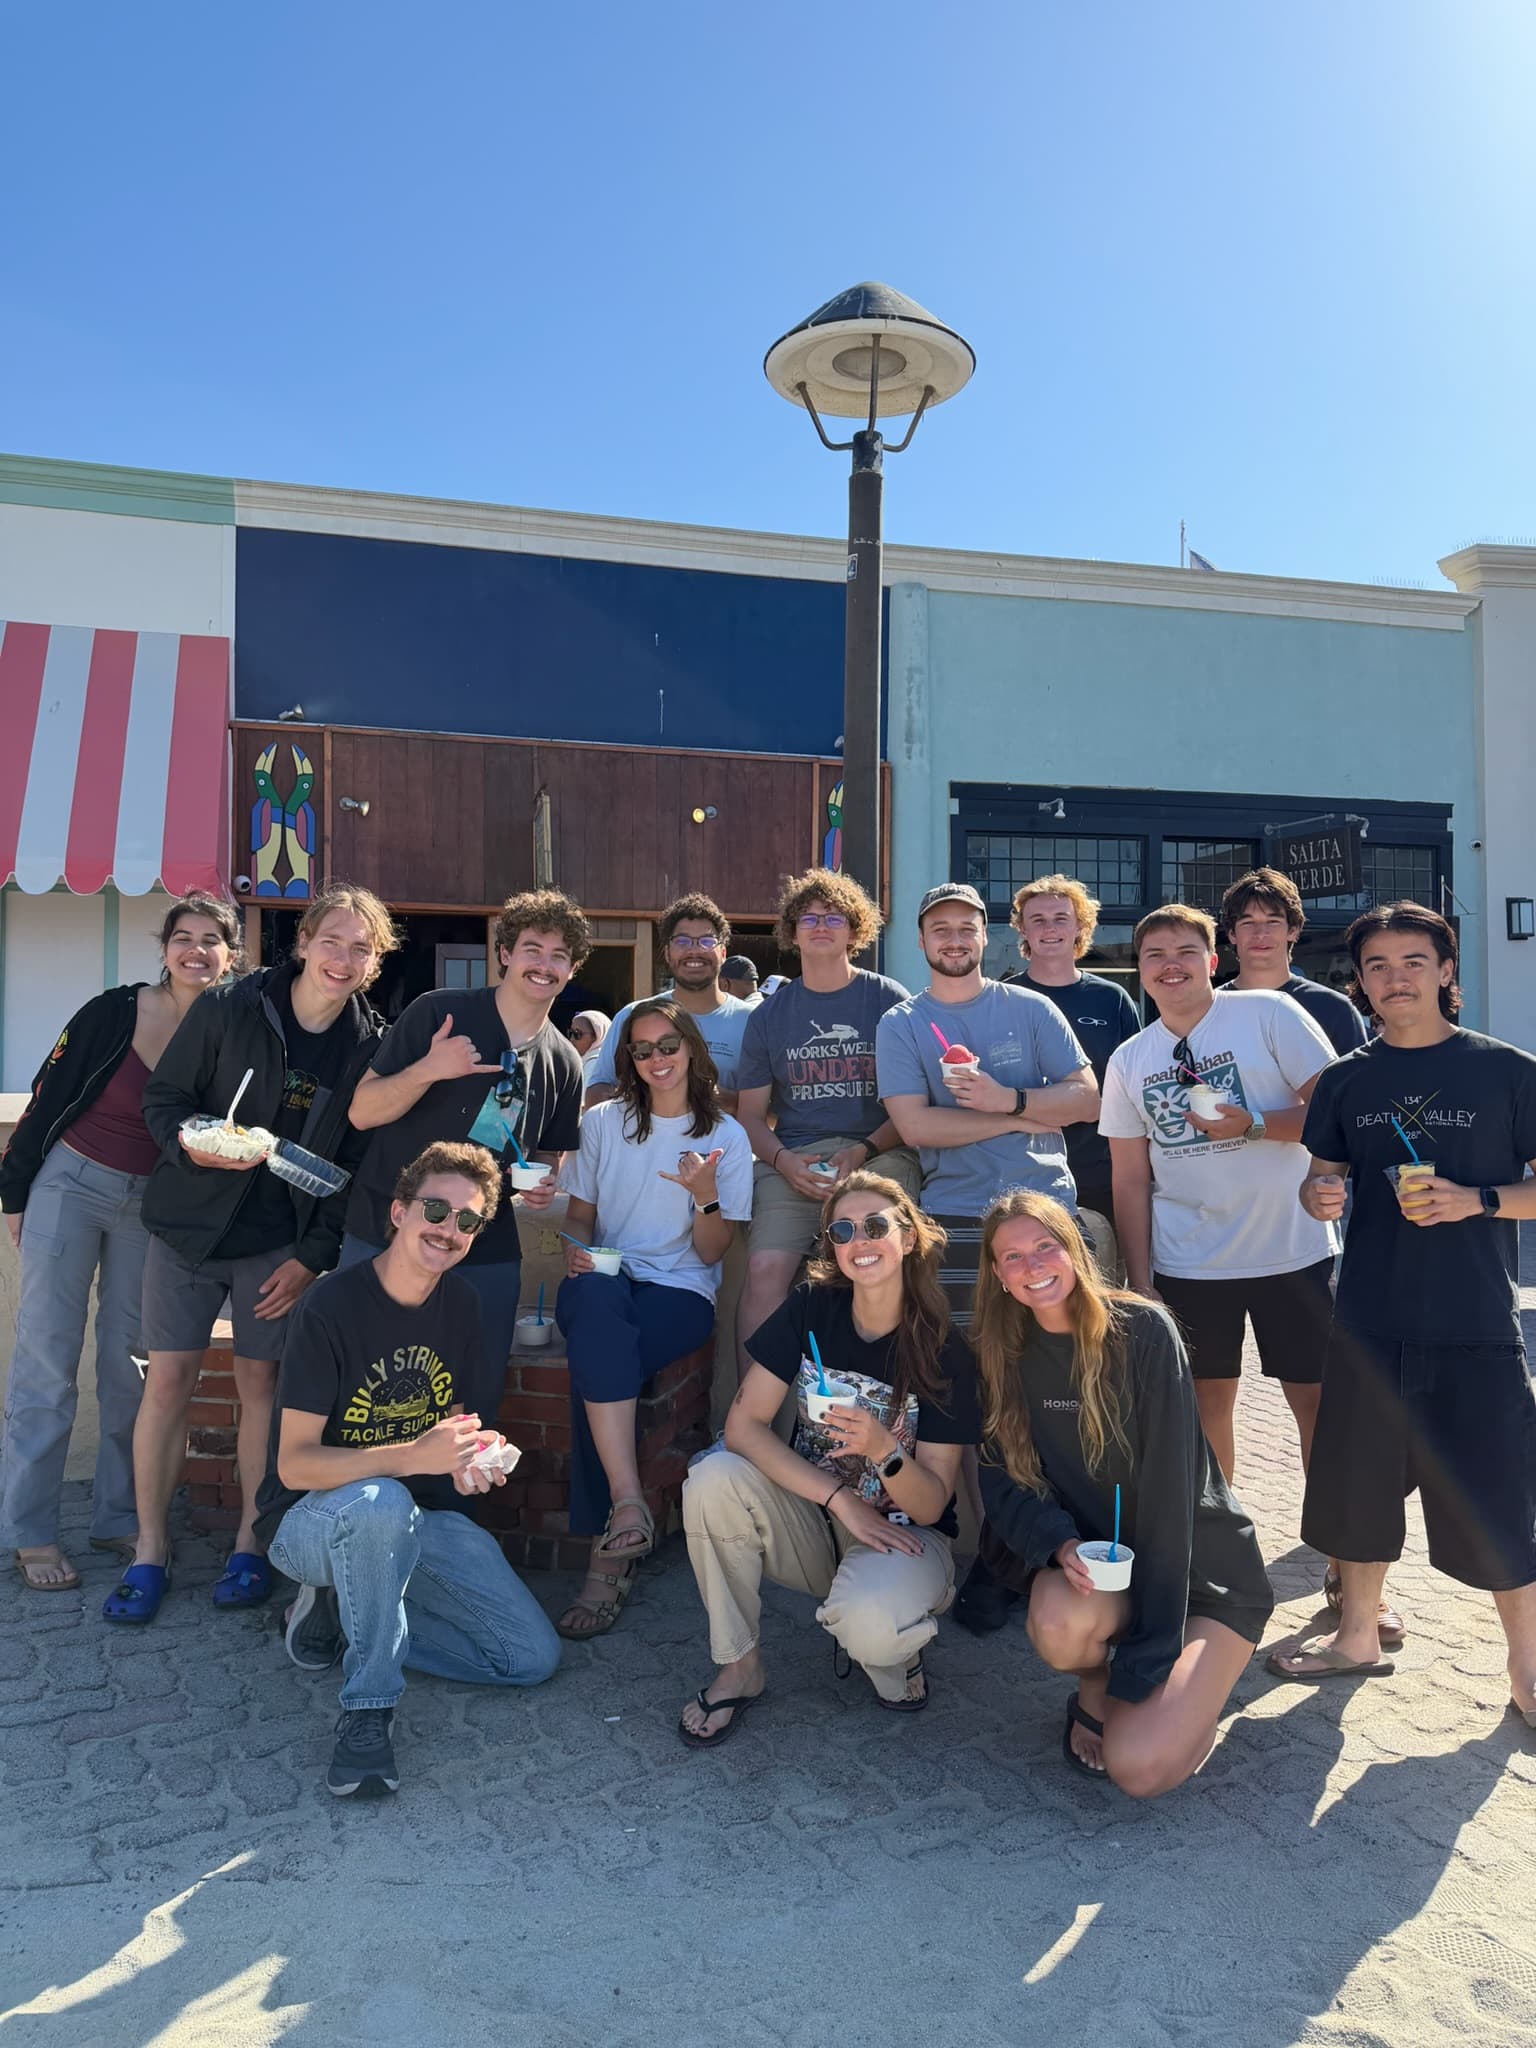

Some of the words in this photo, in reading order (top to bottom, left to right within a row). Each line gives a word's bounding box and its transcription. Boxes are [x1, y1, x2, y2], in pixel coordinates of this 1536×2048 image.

[1289, 838, 1342, 865] SALTA
[1288, 864, 1345, 890] VERDE
[786, 1044, 839, 1060] WORKS
[1194, 1050, 1234, 1073] ahan
[786, 1056, 876, 1084] UNDER
[791, 1081, 875, 1100] PRESSURE
[1356, 1111, 1402, 1128] DEATH
[1422, 1109, 1477, 1123] VALLEY
[1192, 1145, 1211, 1153] HERE
[1212, 1139, 1248, 1150] FOREVER
[343, 1357, 389, 1423] BILLY
[393, 1345, 453, 1407] STRINGS
[1043, 1399, 1079, 1408] HONO
[341, 1423, 397, 1442] TACKLE
